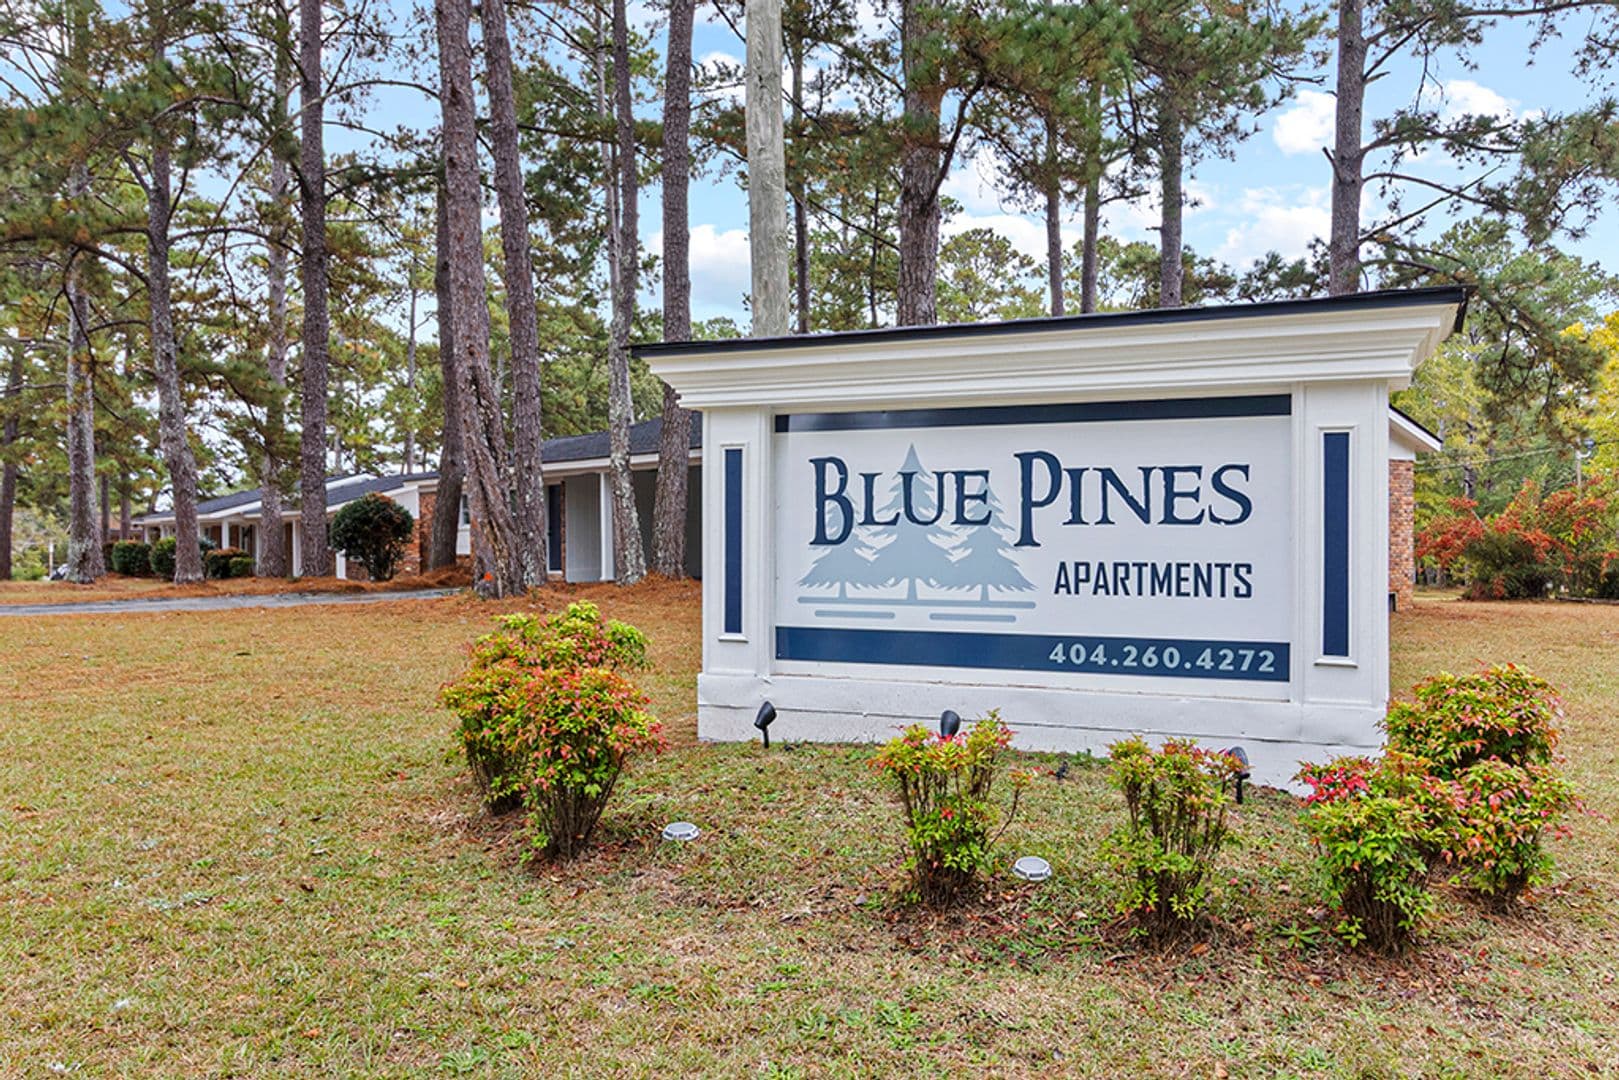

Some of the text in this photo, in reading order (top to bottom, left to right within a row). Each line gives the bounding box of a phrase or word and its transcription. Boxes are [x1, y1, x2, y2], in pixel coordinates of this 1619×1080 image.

[808, 450, 1253, 547] BLUE PINES
[1053, 561, 1253, 599] APARTMENTS
[1049, 642, 1276, 673] 404.260.4272
